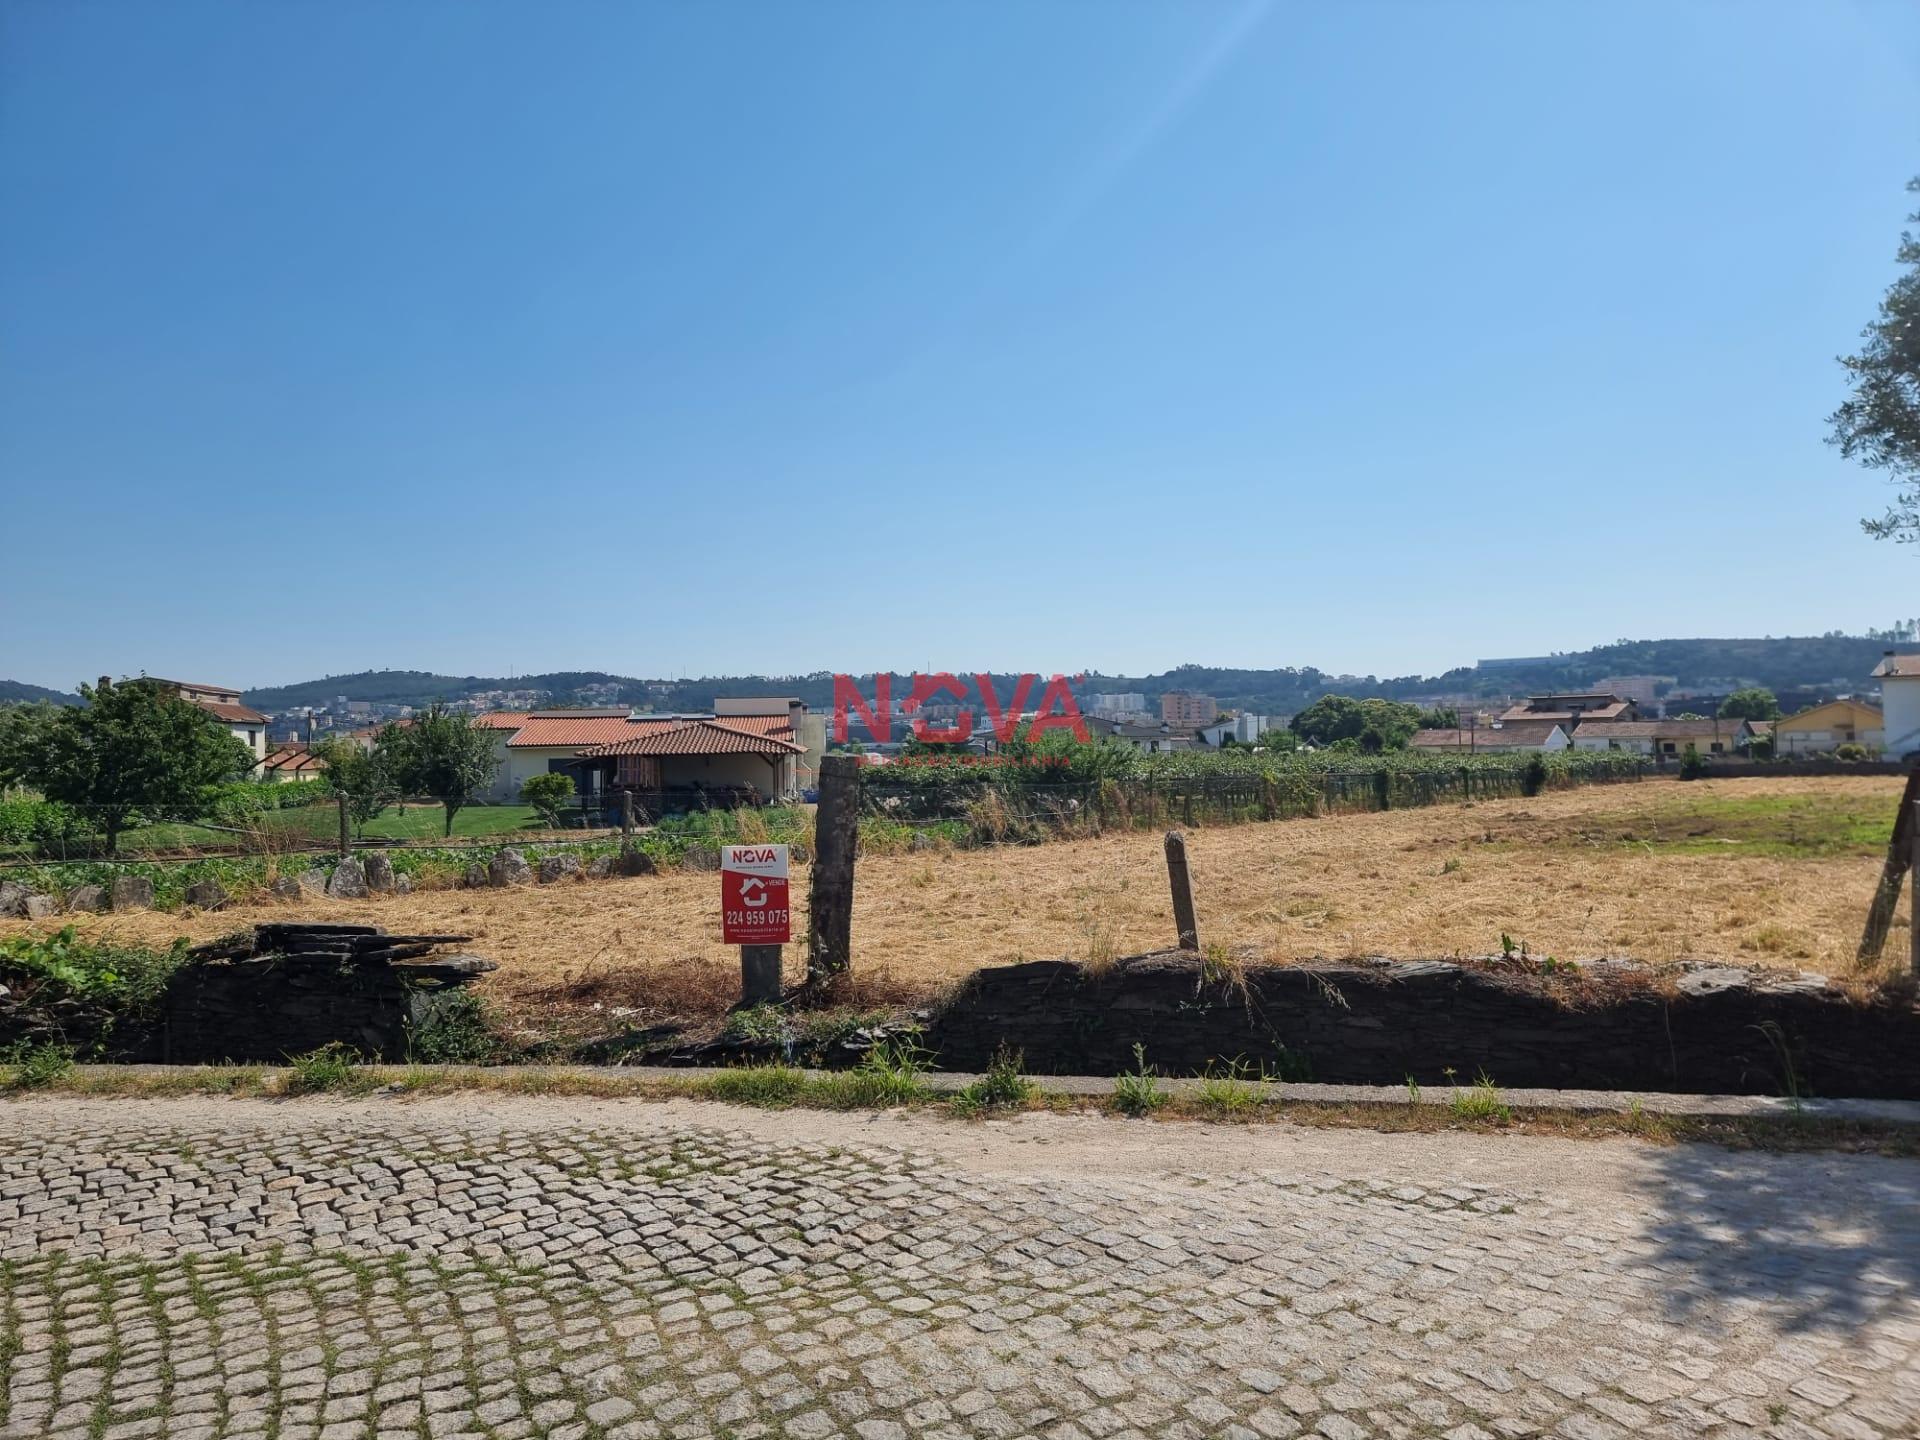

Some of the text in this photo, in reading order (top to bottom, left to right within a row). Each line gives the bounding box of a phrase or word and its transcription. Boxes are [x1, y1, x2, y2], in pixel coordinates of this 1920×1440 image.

[732, 849, 776, 863] NOVA
[727, 909, 788, 925] 224 959 075
